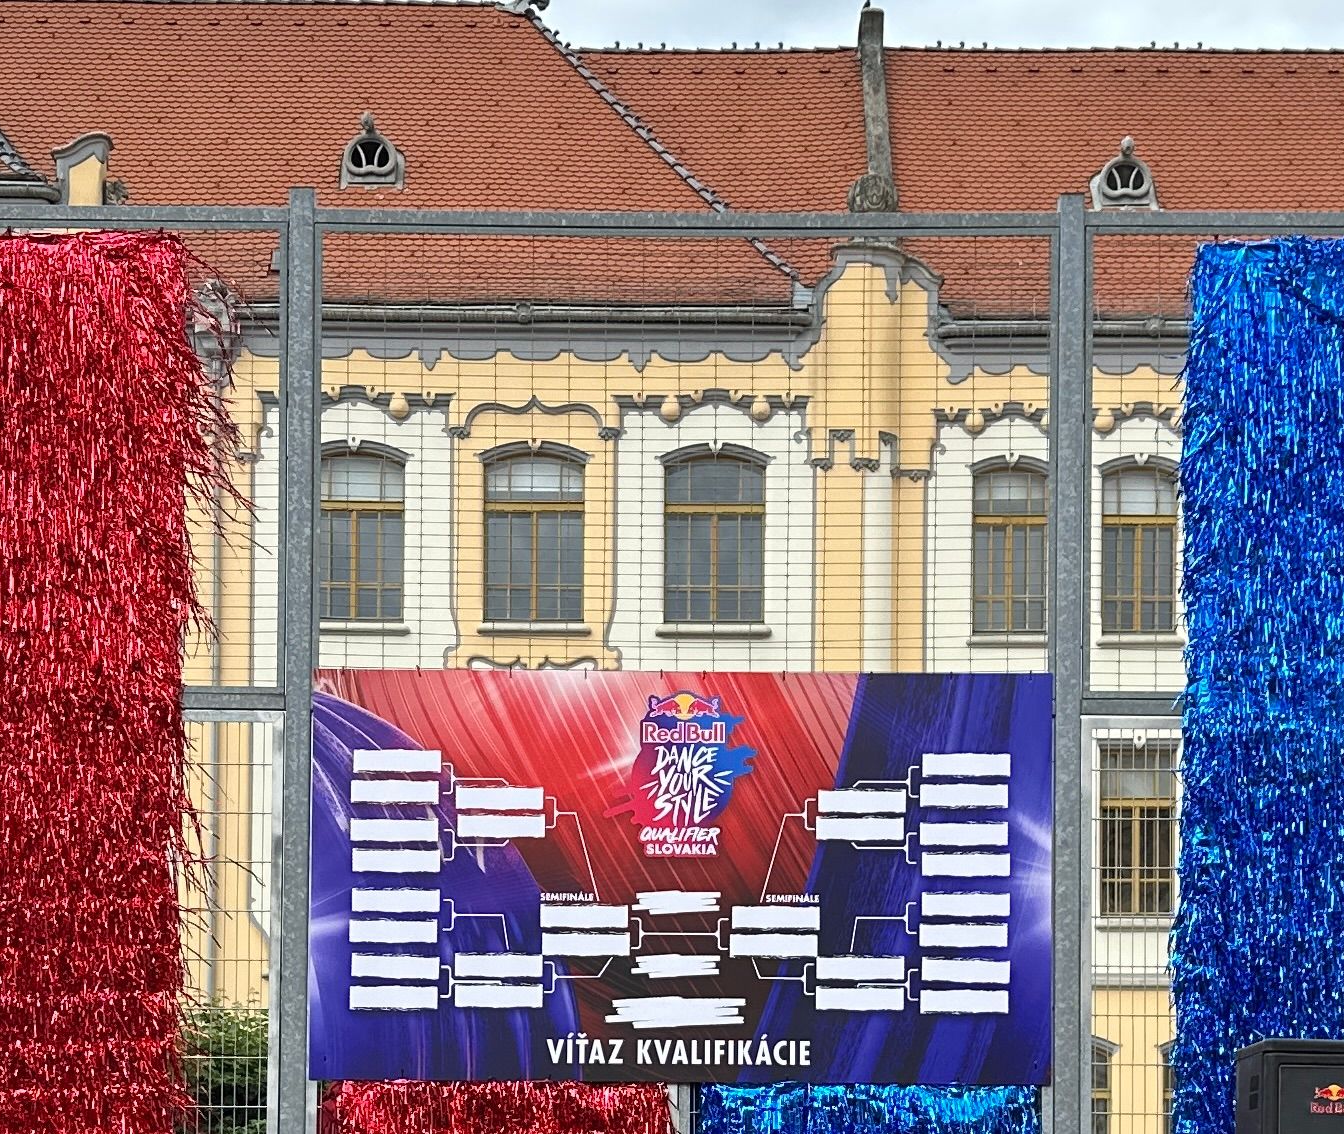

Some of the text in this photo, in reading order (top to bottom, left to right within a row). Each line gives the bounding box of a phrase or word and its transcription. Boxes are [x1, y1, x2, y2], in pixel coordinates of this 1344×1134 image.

[643, 722, 725, 743] Red Bull
[651, 744, 719, 775] DANCE
[658, 765, 725, 796] YOUR
[652, 784, 720, 826] STYLE
[640, 826, 721, 845] QUALIFIER
[646, 844, 717, 855] SLOVAKIA
[540, 891, 594, 902] SEMIFINÁLE
[546, 1032, 811, 1066] VÍŤAZ KVALIFIKÁCIE
